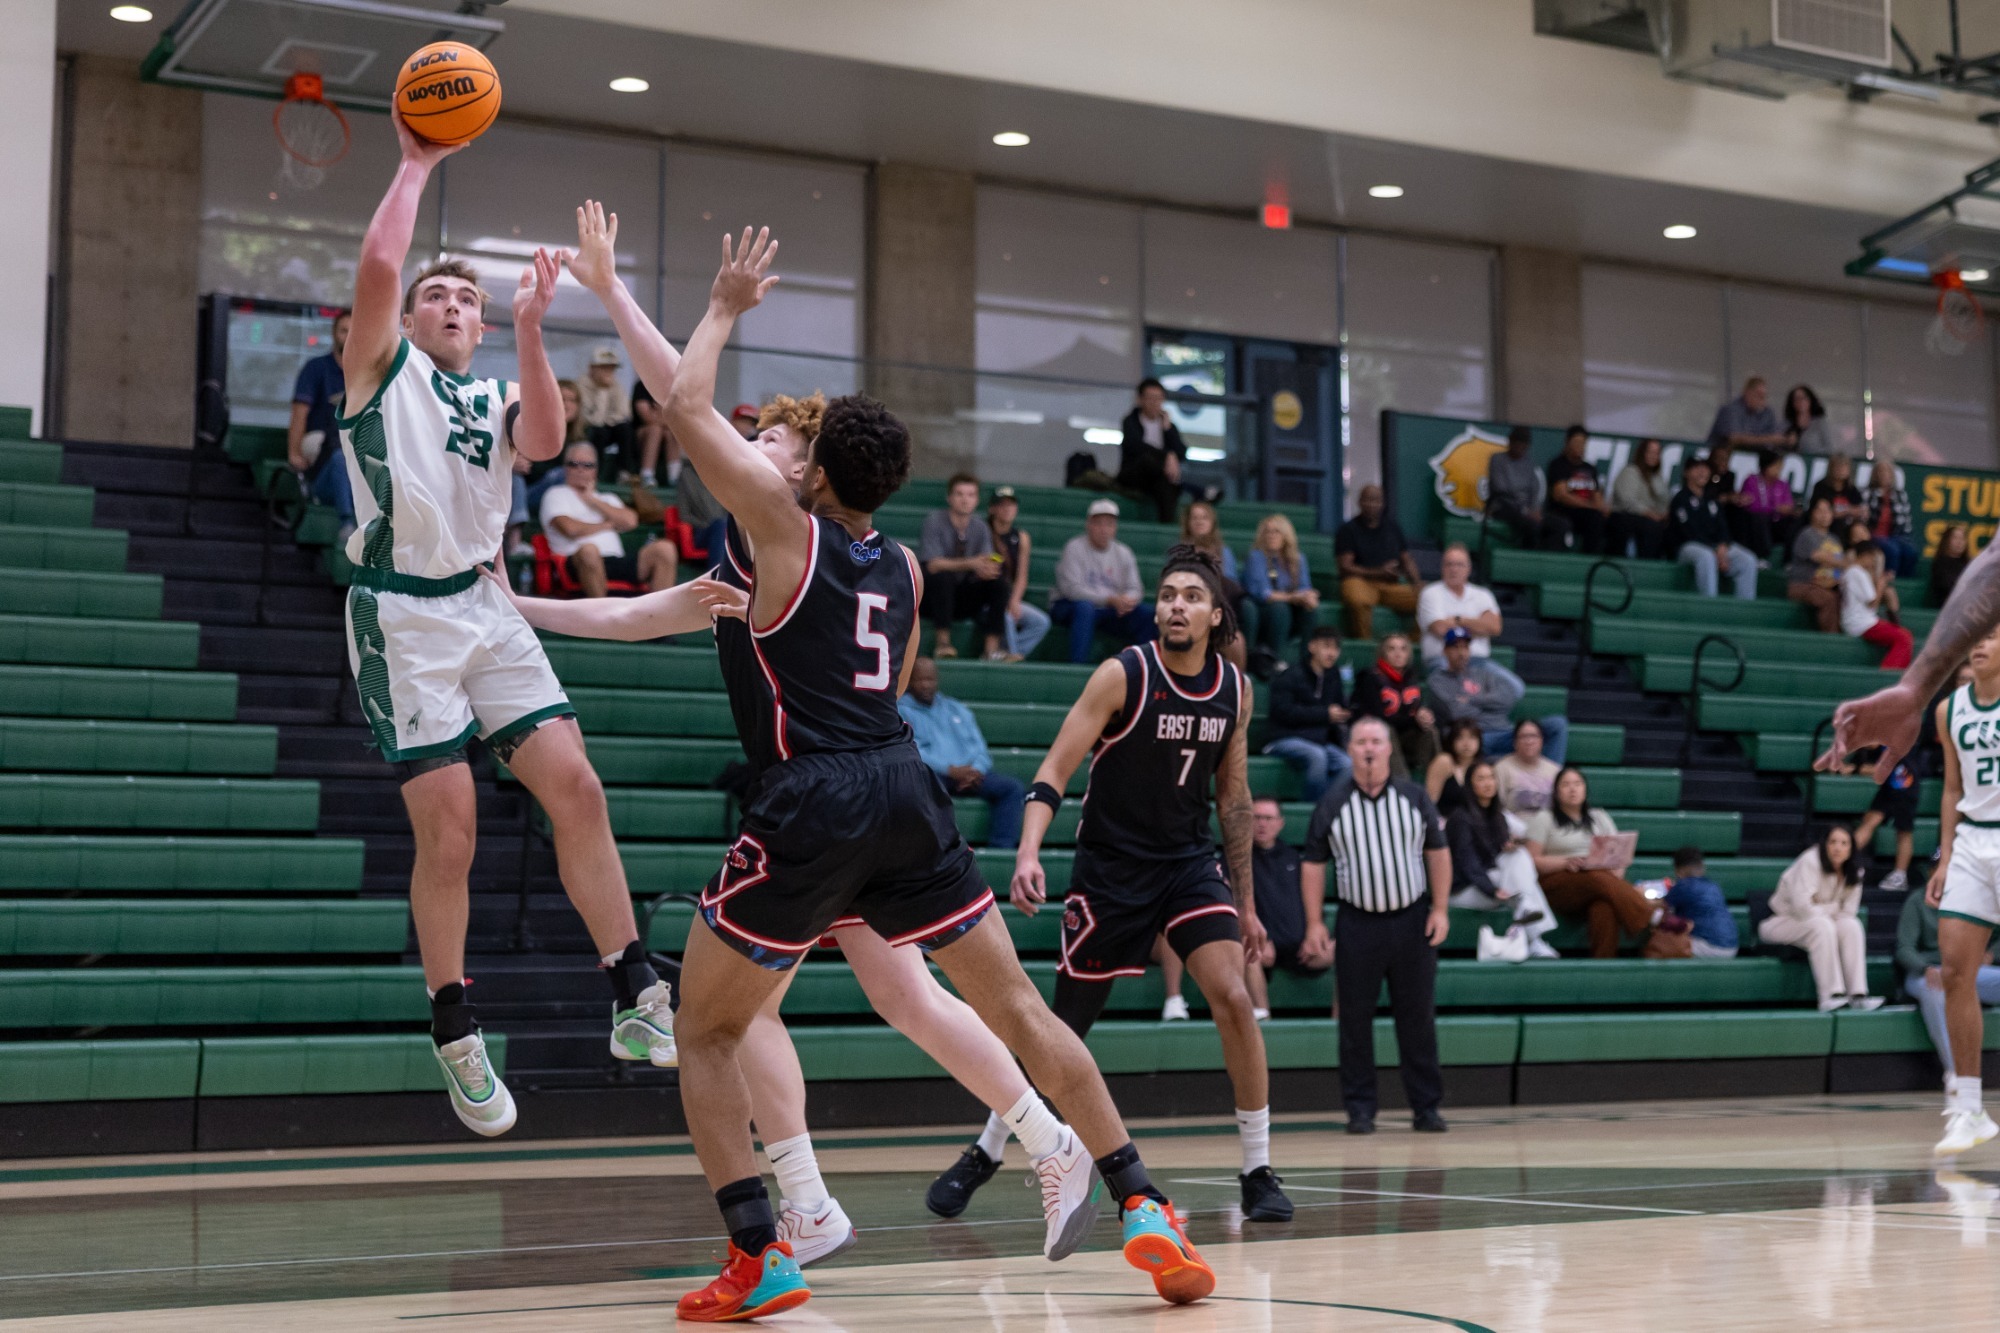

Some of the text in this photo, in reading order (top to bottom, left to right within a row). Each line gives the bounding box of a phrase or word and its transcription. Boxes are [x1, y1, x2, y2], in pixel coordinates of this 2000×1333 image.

[410, 52, 458, 72] NCAA
[407, 76, 477, 102] Wilson
[445, 416, 493, 472] 23
[853, 592, 890, 692] 5
[1157, 714, 1227, 742] EAST BAY
[1178, 748, 1196, 786] 7
